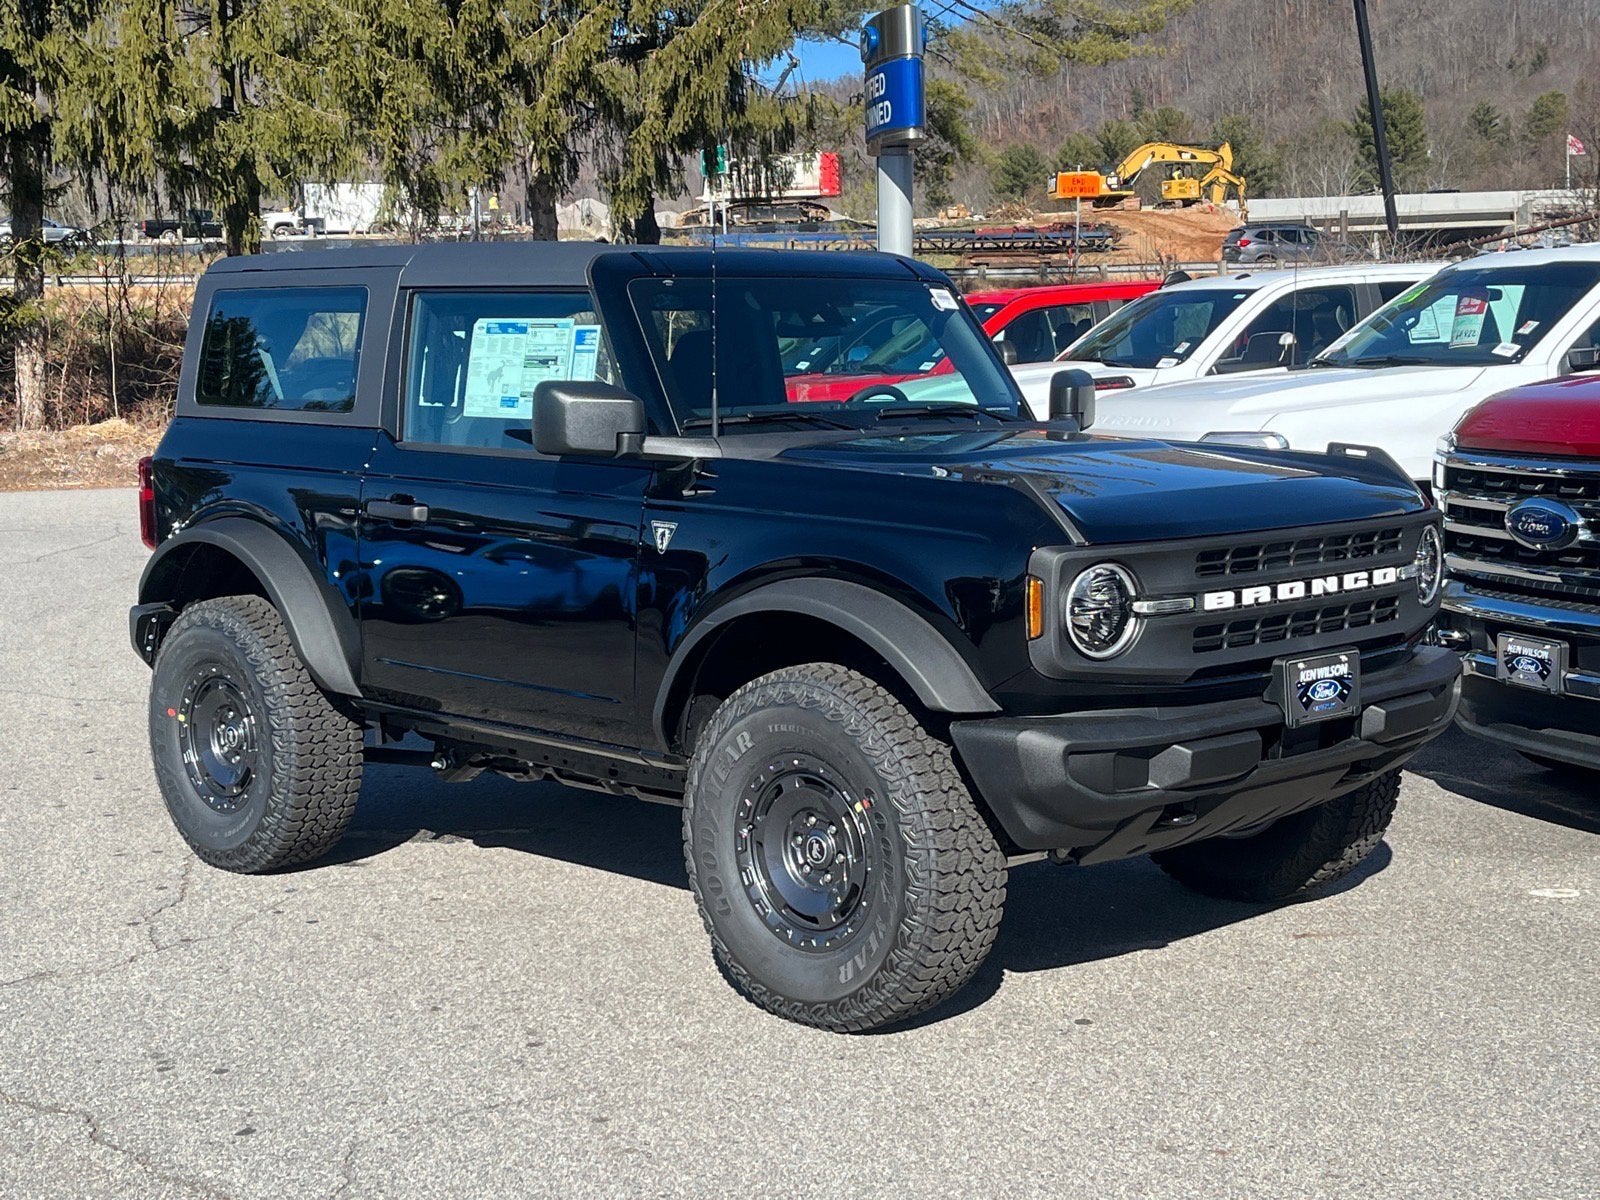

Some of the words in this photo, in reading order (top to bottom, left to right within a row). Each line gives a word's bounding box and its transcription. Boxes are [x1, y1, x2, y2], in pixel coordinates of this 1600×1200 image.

[1204, 567, 1397, 611] BRONCO
[1507, 643, 1522, 655] KEN
[1522, 646, 1550, 660] WILSON
[1300, 668, 1317, 682] KEN
[1316, 662, 1349, 680] WILSON
[1519, 658, 1537, 671] Ford
[1315, 682, 1335, 698] Ford
